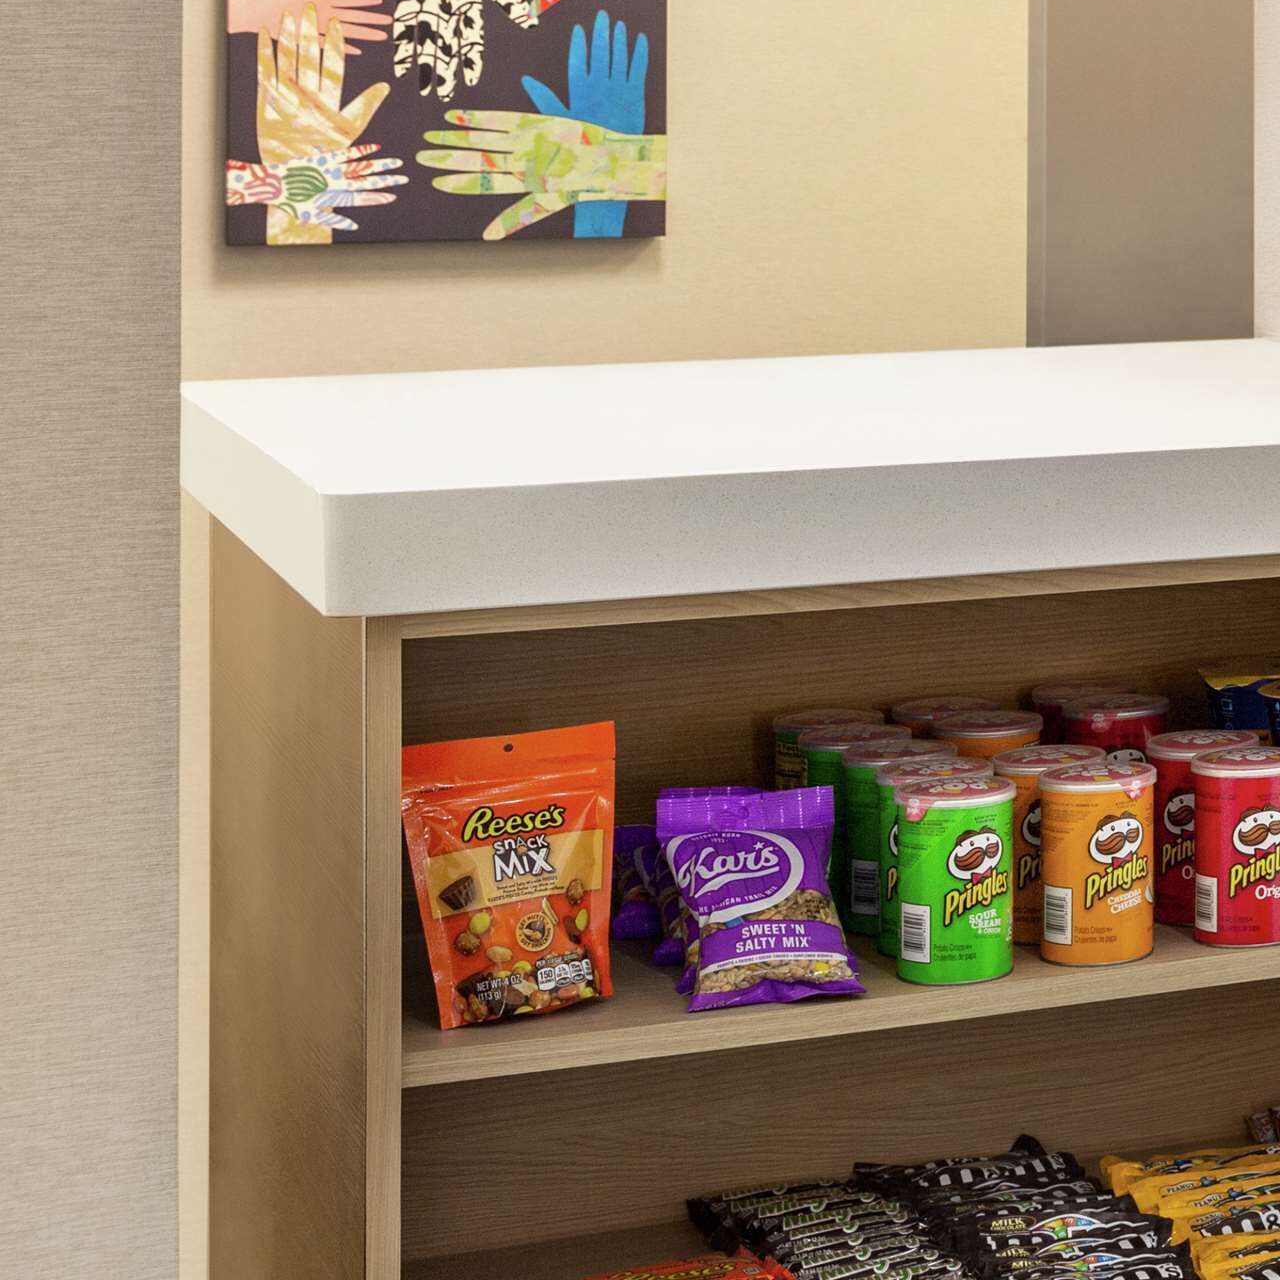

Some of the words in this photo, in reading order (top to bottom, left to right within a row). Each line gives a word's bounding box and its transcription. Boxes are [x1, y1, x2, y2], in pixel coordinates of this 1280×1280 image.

[463, 805, 565, 841] Reese's
[678, 842, 780, 897] Kar's
[1085, 853, 1149, 910] Pringles
[943, 870, 1008, 926] Pringles
[968, 909, 997, 922] SOUR
[741, 923, 787, 939] SWEET
[790, 923, 805, 935] 'N
[735, 937, 777, 953] SALTY
[782, 936, 809, 949] MIX
[539, 969, 553, 979] 150
[477, 982, 490, 992] NET
[991, 1216, 1024, 1228] MILK
